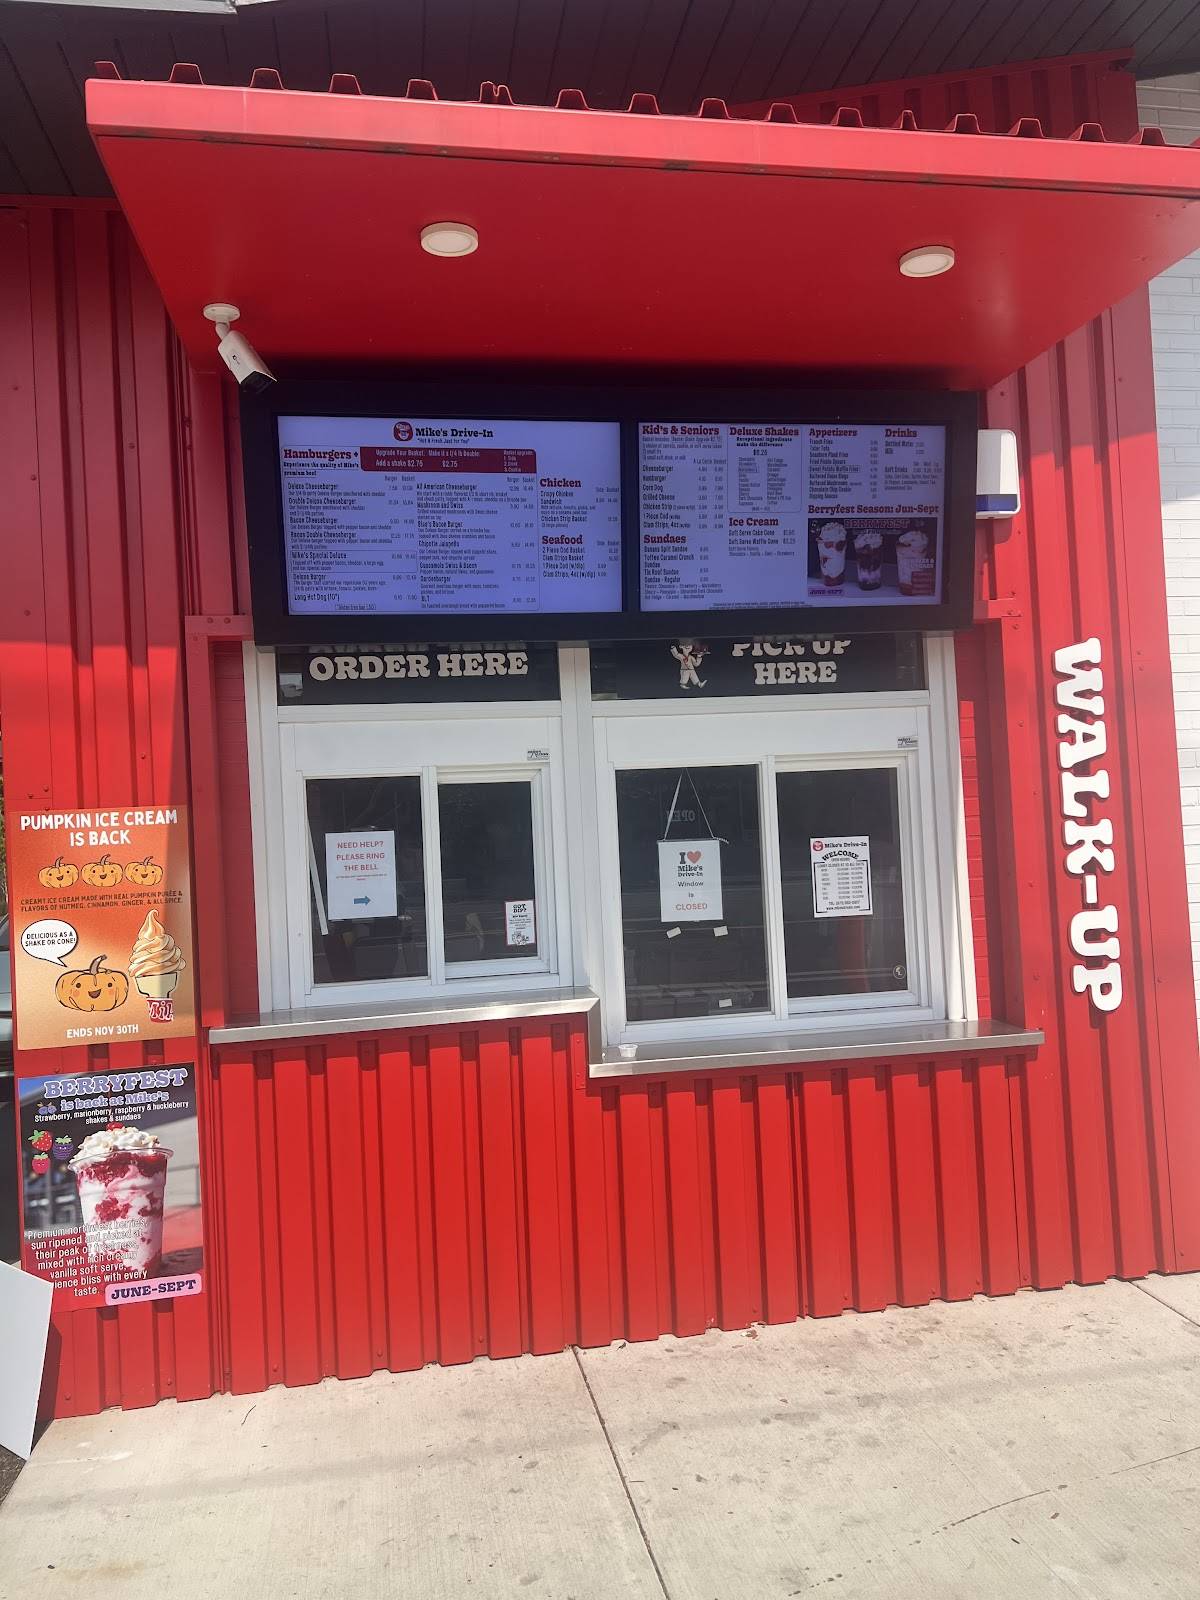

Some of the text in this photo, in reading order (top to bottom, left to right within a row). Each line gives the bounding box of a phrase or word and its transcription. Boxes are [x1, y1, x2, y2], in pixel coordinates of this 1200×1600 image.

[415, 427, 448, 437] Mike's
[450, 427, 494, 438] Drive-In
[642, 425, 720, 435] Kid's & Seniors
[730, 427, 799, 436] Deluxe Shakes
[809, 428, 857, 438] Appetizers
[885, 428, 917, 437] Drinks
[283, 449, 351, 461] Hamburgers
[540, 478, 581, 487] Chicken
[808, 504, 939, 515] Berryfest Season: Jun-Sept
[729, 518, 779, 526] Ice Cream
[542, 534, 583, 545] Seafood
[643, 533, 687, 544] Sundaes
[732, 642, 805, 656] PICK
[309, 652, 529, 681] ORDER HERE
[754, 661, 837, 684] HERE
[20, 809, 178, 831] PUMPKIN ICE CREAM
[1054, 638, 1123, 1011] WALK-UP
[70, 829, 131, 847] IS BACK
[336, 853, 364, 861] PLEASE
[679, 852, 686, 864] I
[822, 850, 859, 861] WELCOME
[675, 903, 708, 911] CLOSED
[66, 1024, 139, 1038] ENDS NOV 30TH
[44, 1068, 188, 1098] BERRYFEST
[61, 1091, 169, 1111] is back at Mike's
[34, 1113, 72, 1123] Strawberry,
[74, 1108, 113, 1119] marionberry,
[115, 1106, 145, 1114] raspberry
[153, 1102, 189, 1110] huckleberry
[86, 1116, 107, 1124] shakes
[28, 1228, 65, 1240] Premium
[31, 1240, 46, 1250] sun
[49, 1235, 82, 1249] ripened
[35, 1250, 56, 1259] their
[59, 1246, 80, 1258] peak
[38, 1258, 64, 1270] mixed
[66, 1256, 84, 1266] with
[87, 1253, 104, 1263] rich
[50, 1268, 77, 1279] vanilla
[80, 1264, 97, 1274] soft
[54, 1270, 147, 1289] ience bliss with every
[74, 1286, 100, 1296] taste.
[111, 1279, 197, 1300] JUNE-SEPT
